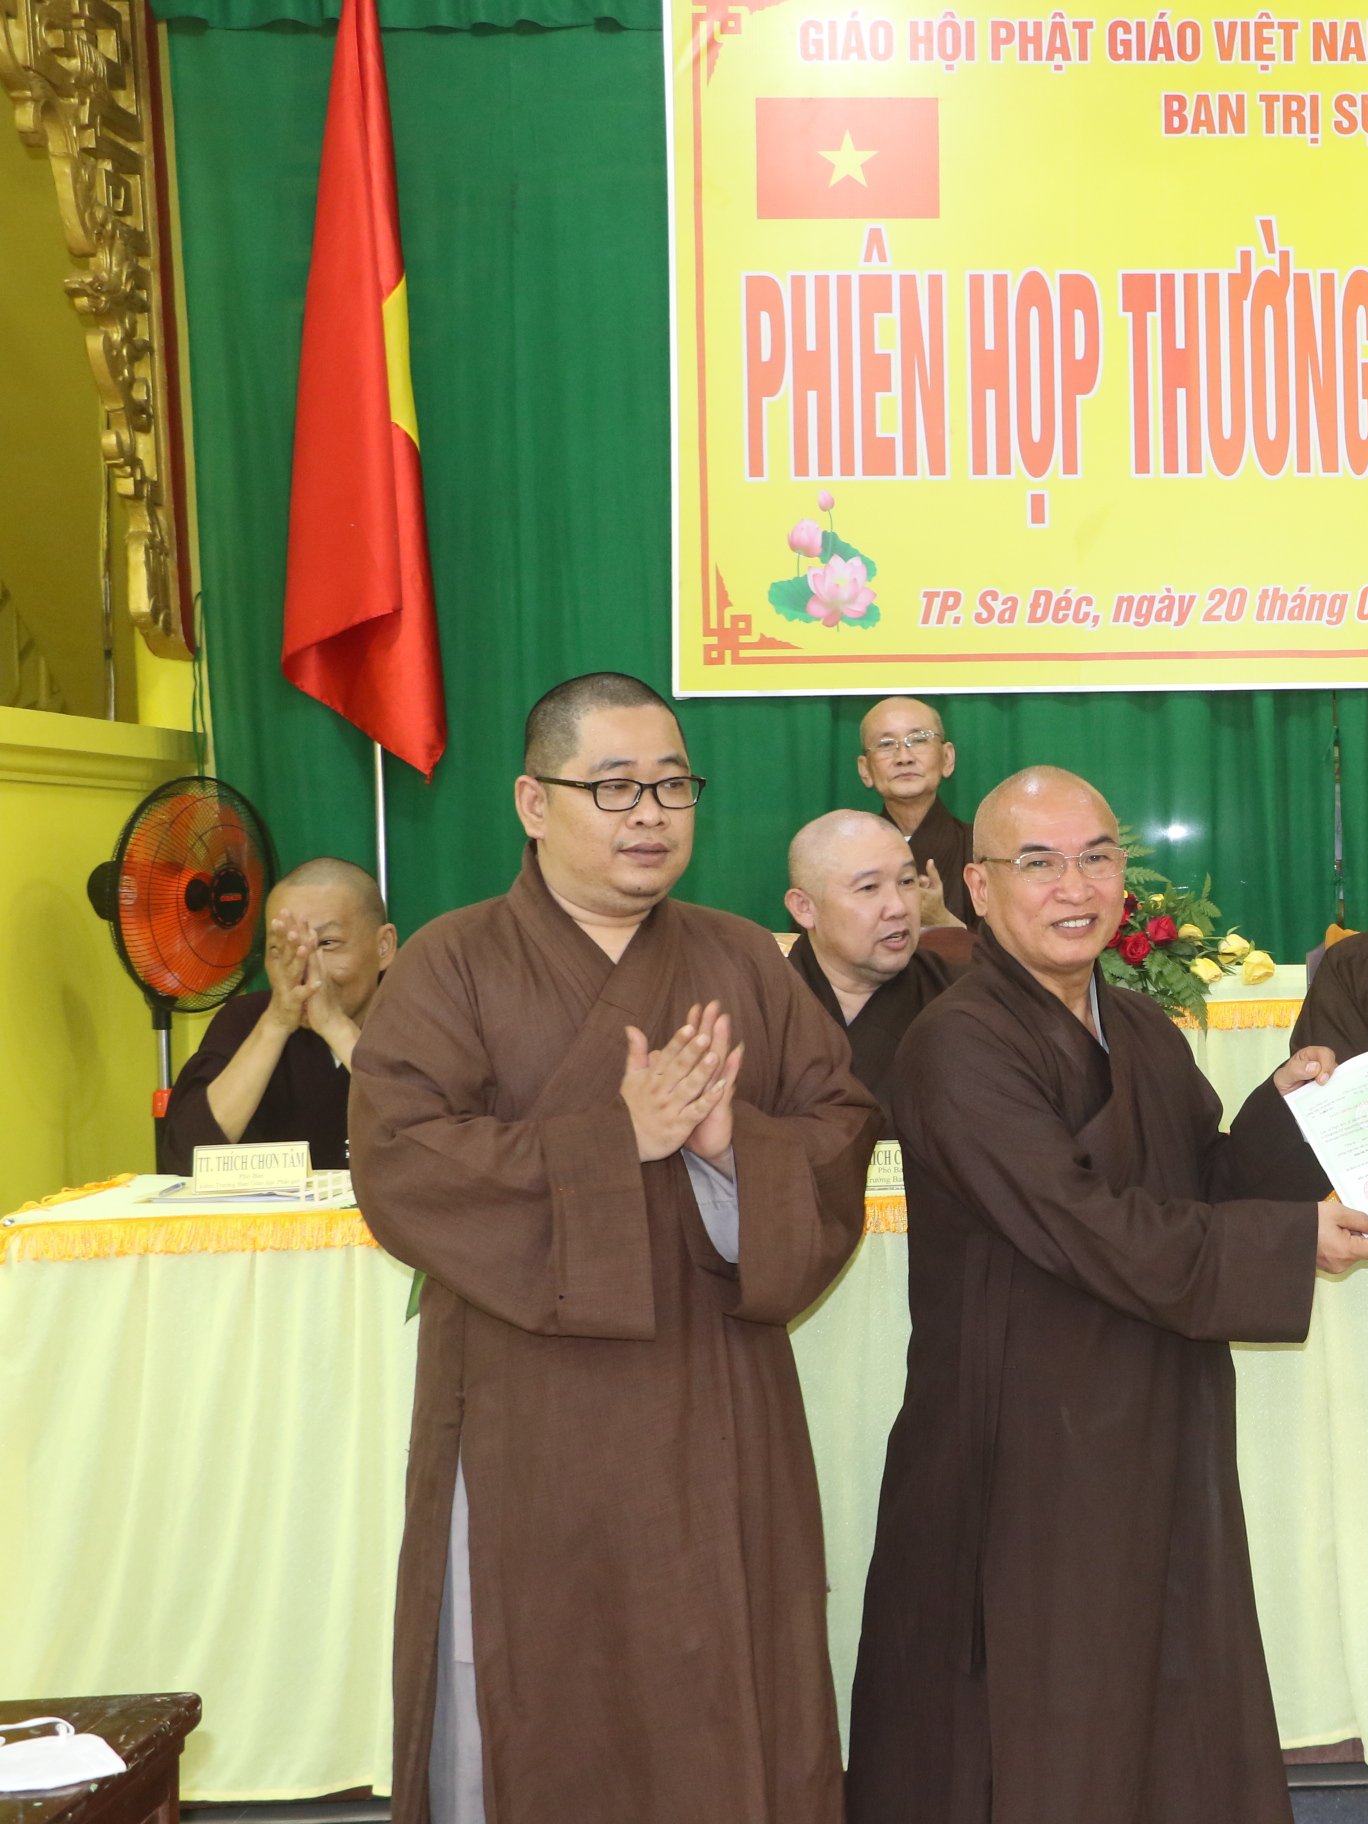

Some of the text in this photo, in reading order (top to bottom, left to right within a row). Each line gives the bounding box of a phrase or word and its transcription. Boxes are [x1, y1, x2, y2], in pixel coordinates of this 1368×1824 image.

[799, 10, 894, 62] GIÁO
[908, 11, 976, 71] HỘI
[989, 11, 1094, 71] PHẬT
[1106, 11, 1202, 62] GIÁO
[1213, 11, 1299, 71] VIỆT
[1162, 93, 1246, 135] BAN
[1259, 93, 1321, 145] TRỊ
[743, 226, 948, 479] PHIÊN
[966, 269, 1102, 525] HỌP
[920, 590, 962, 625] TP.
[974, 589, 1020, 624] Sa
[1026, 588, 1101, 628] Đéc,
[1112, 586, 1197, 628] ngày
[1202, 586, 1249, 623] 20
[1255, 585, 1349, 627] tháng
[216, 1151, 249, 1171] THÍCH
